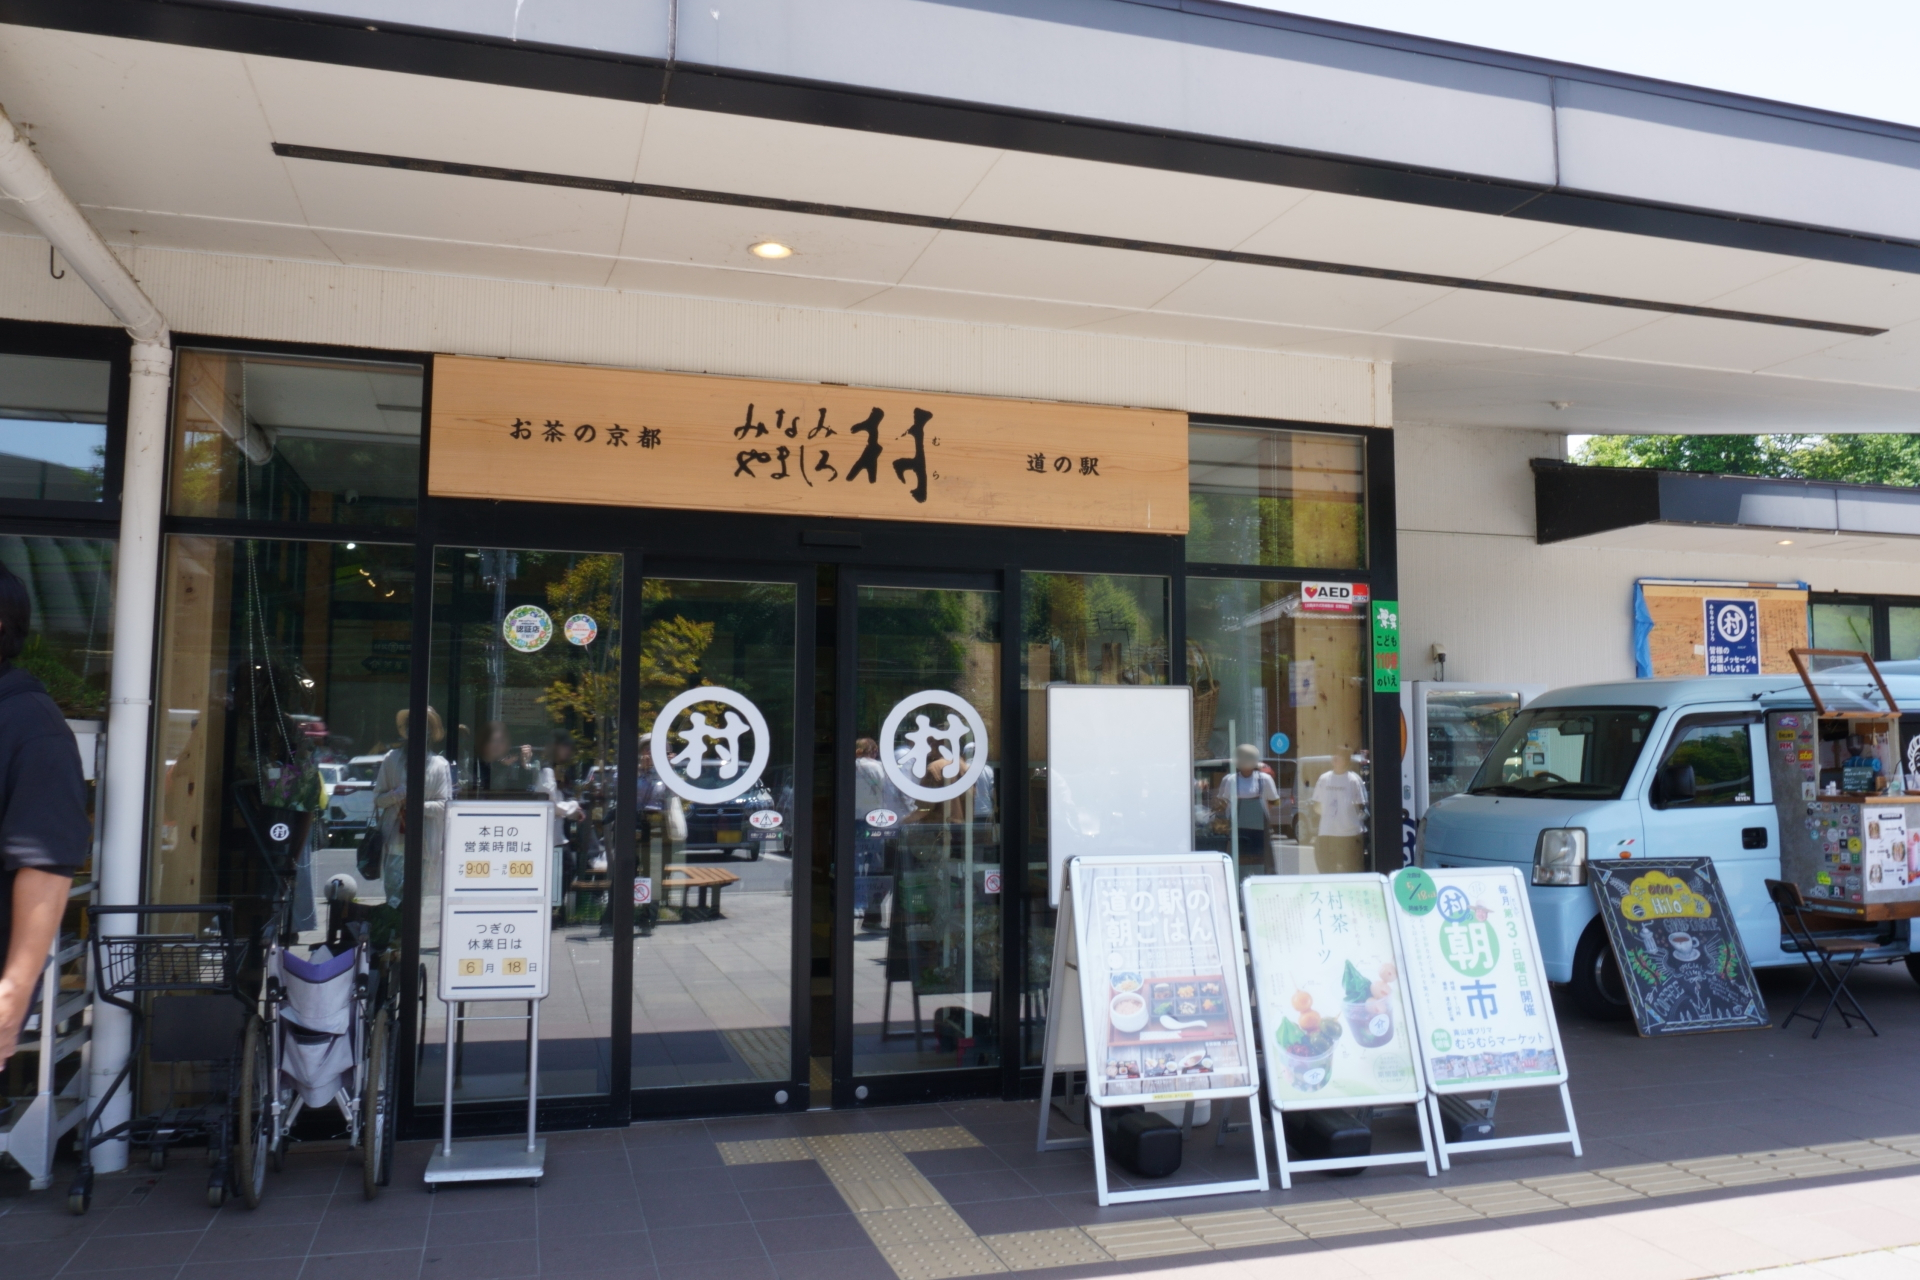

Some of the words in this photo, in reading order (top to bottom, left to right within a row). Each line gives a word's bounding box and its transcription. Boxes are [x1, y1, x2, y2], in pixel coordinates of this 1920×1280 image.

[510, 417, 662, 450] お茶の京都
[845, 406, 934, 503] 村
[1026, 452, 1102, 477] 道の駅
[1318, 586, 1350, 598] AED
[1376, 635, 1397, 647] こども
[1376, 652, 1398, 669] 110番
[1377, 675, 1397, 687] のいえ
[479, 826, 519, 837] 本日の
[464, 841, 532, 853] 営業時間は
[466, 863, 490, 875] 9:00
[509, 863, 533, 875] 6:00
[1102, 888, 1210, 916] 道の駅の
[1651, 898, 1683, 914] Hilo
[1327, 890, 1348, 934] 村茶
[476, 923, 515, 934] つぎの
[1105, 916, 1213, 947] 朝ごはん
[1310, 891, 1331, 964] スイーツ
[468, 938, 522, 950] 休業日は
[466, 962, 475, 974] 6
[485, 963, 494, 973] 月
[507, 962, 521, 973] 18
[529, 963, 537, 972] 日
[1455, 1031, 1545, 1049] むらむらマーケット
